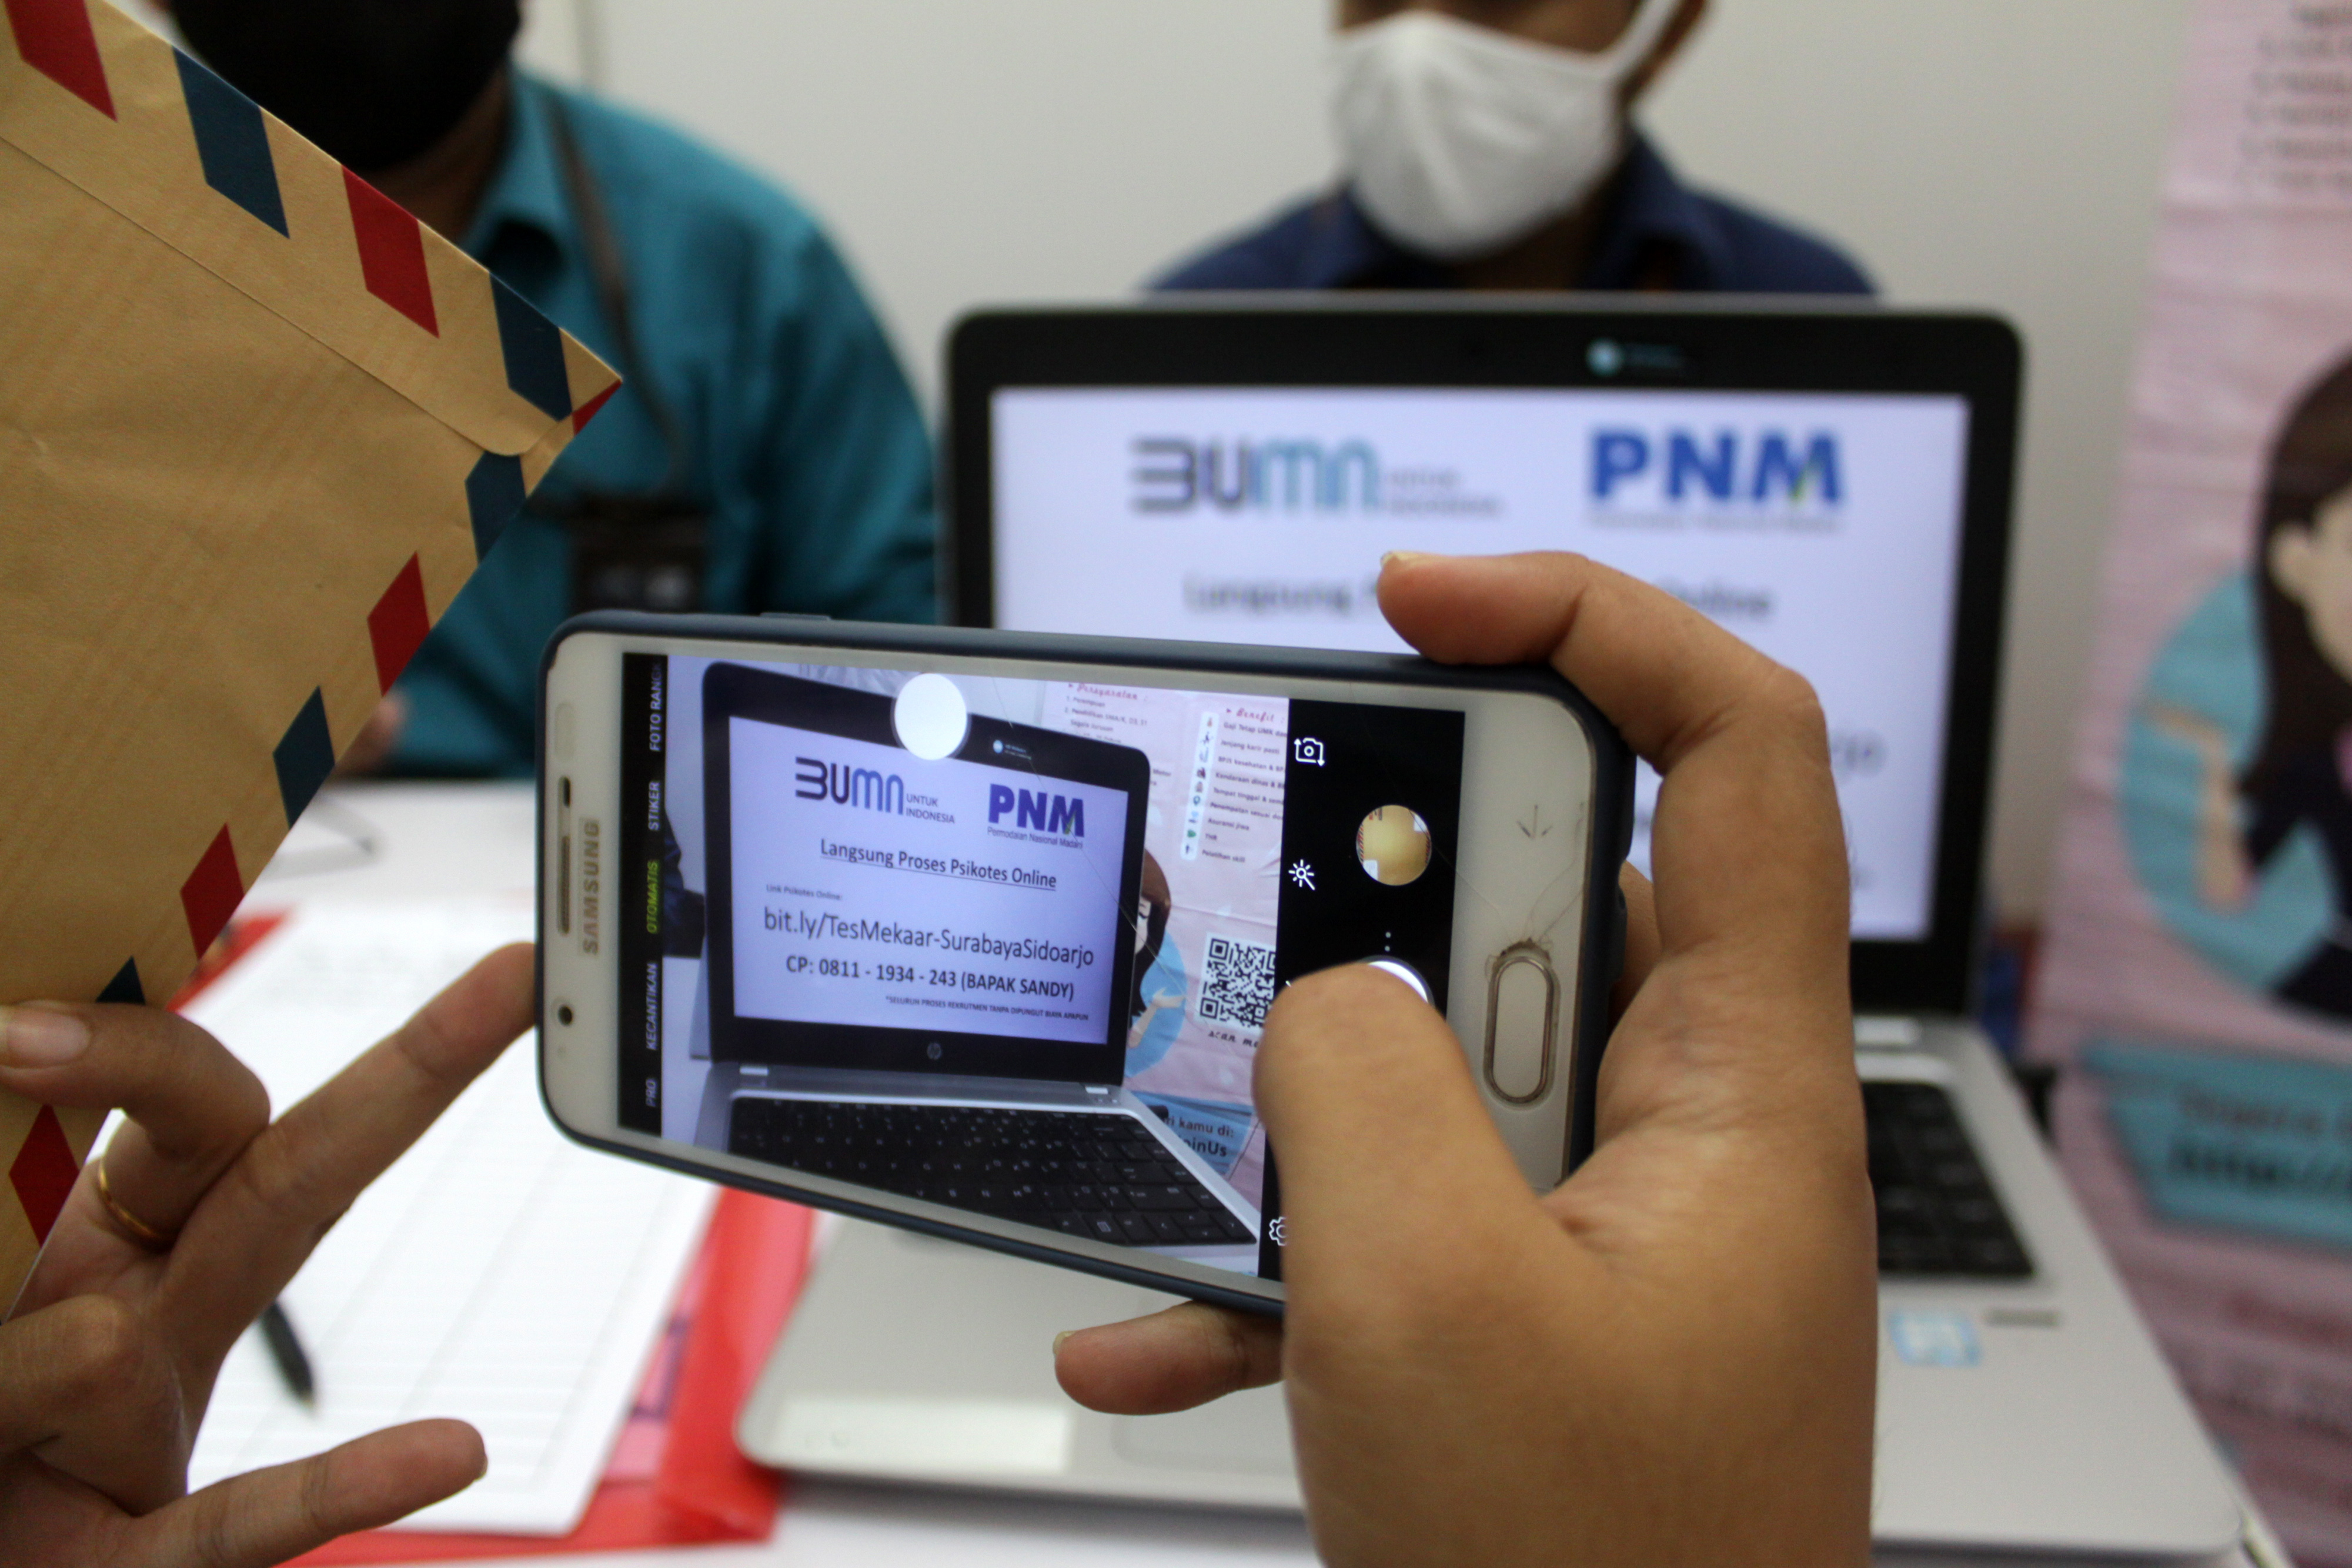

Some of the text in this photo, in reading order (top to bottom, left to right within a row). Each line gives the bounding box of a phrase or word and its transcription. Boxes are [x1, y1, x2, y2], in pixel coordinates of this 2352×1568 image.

[1591, 428, 1843, 503] PNM
[649, 713, 662, 752] FOTO
[648, 780, 660, 831] STIKER
[906, 793, 938, 808] UNTUK
[906, 807, 956, 824] INDONESIA
[988, 783, 1084, 838] PNM
[821, 838, 1057, 888] Langsung Proses Psikotes Online
[1029, 833, 1058, 846] Nasional
[583, 821, 600, 956] SAMSUNG
[647, 859, 659, 934] OTOMATIS
[764, 906, 1094, 969] bit.ly/TesMekaar-SurabayaSidoarjo
[786, 955, 814, 974] CP:
[818, 958, 860, 978] 0811
[876, 965, 914, 983] 1934
[928, 969, 957, 987] 243
[961, 971, 1016, 994] (BAPAK
[1019, 978, 1074, 1002] SANDY)
[646, 962, 658, 1051] KECANTIKAN
[921, 999, 946, 1008] PROSES
[947, 1001, 988, 1012] REKRUTMEN
[989, 1004, 1010, 1014] TANPA
[1010, 1007, 1044, 1017] DIPUNGUT
[646, 1078, 656, 1108] PRO
[1179, 1117, 1213, 1134] kamu
[1217, 1124, 1234, 1138] di:
